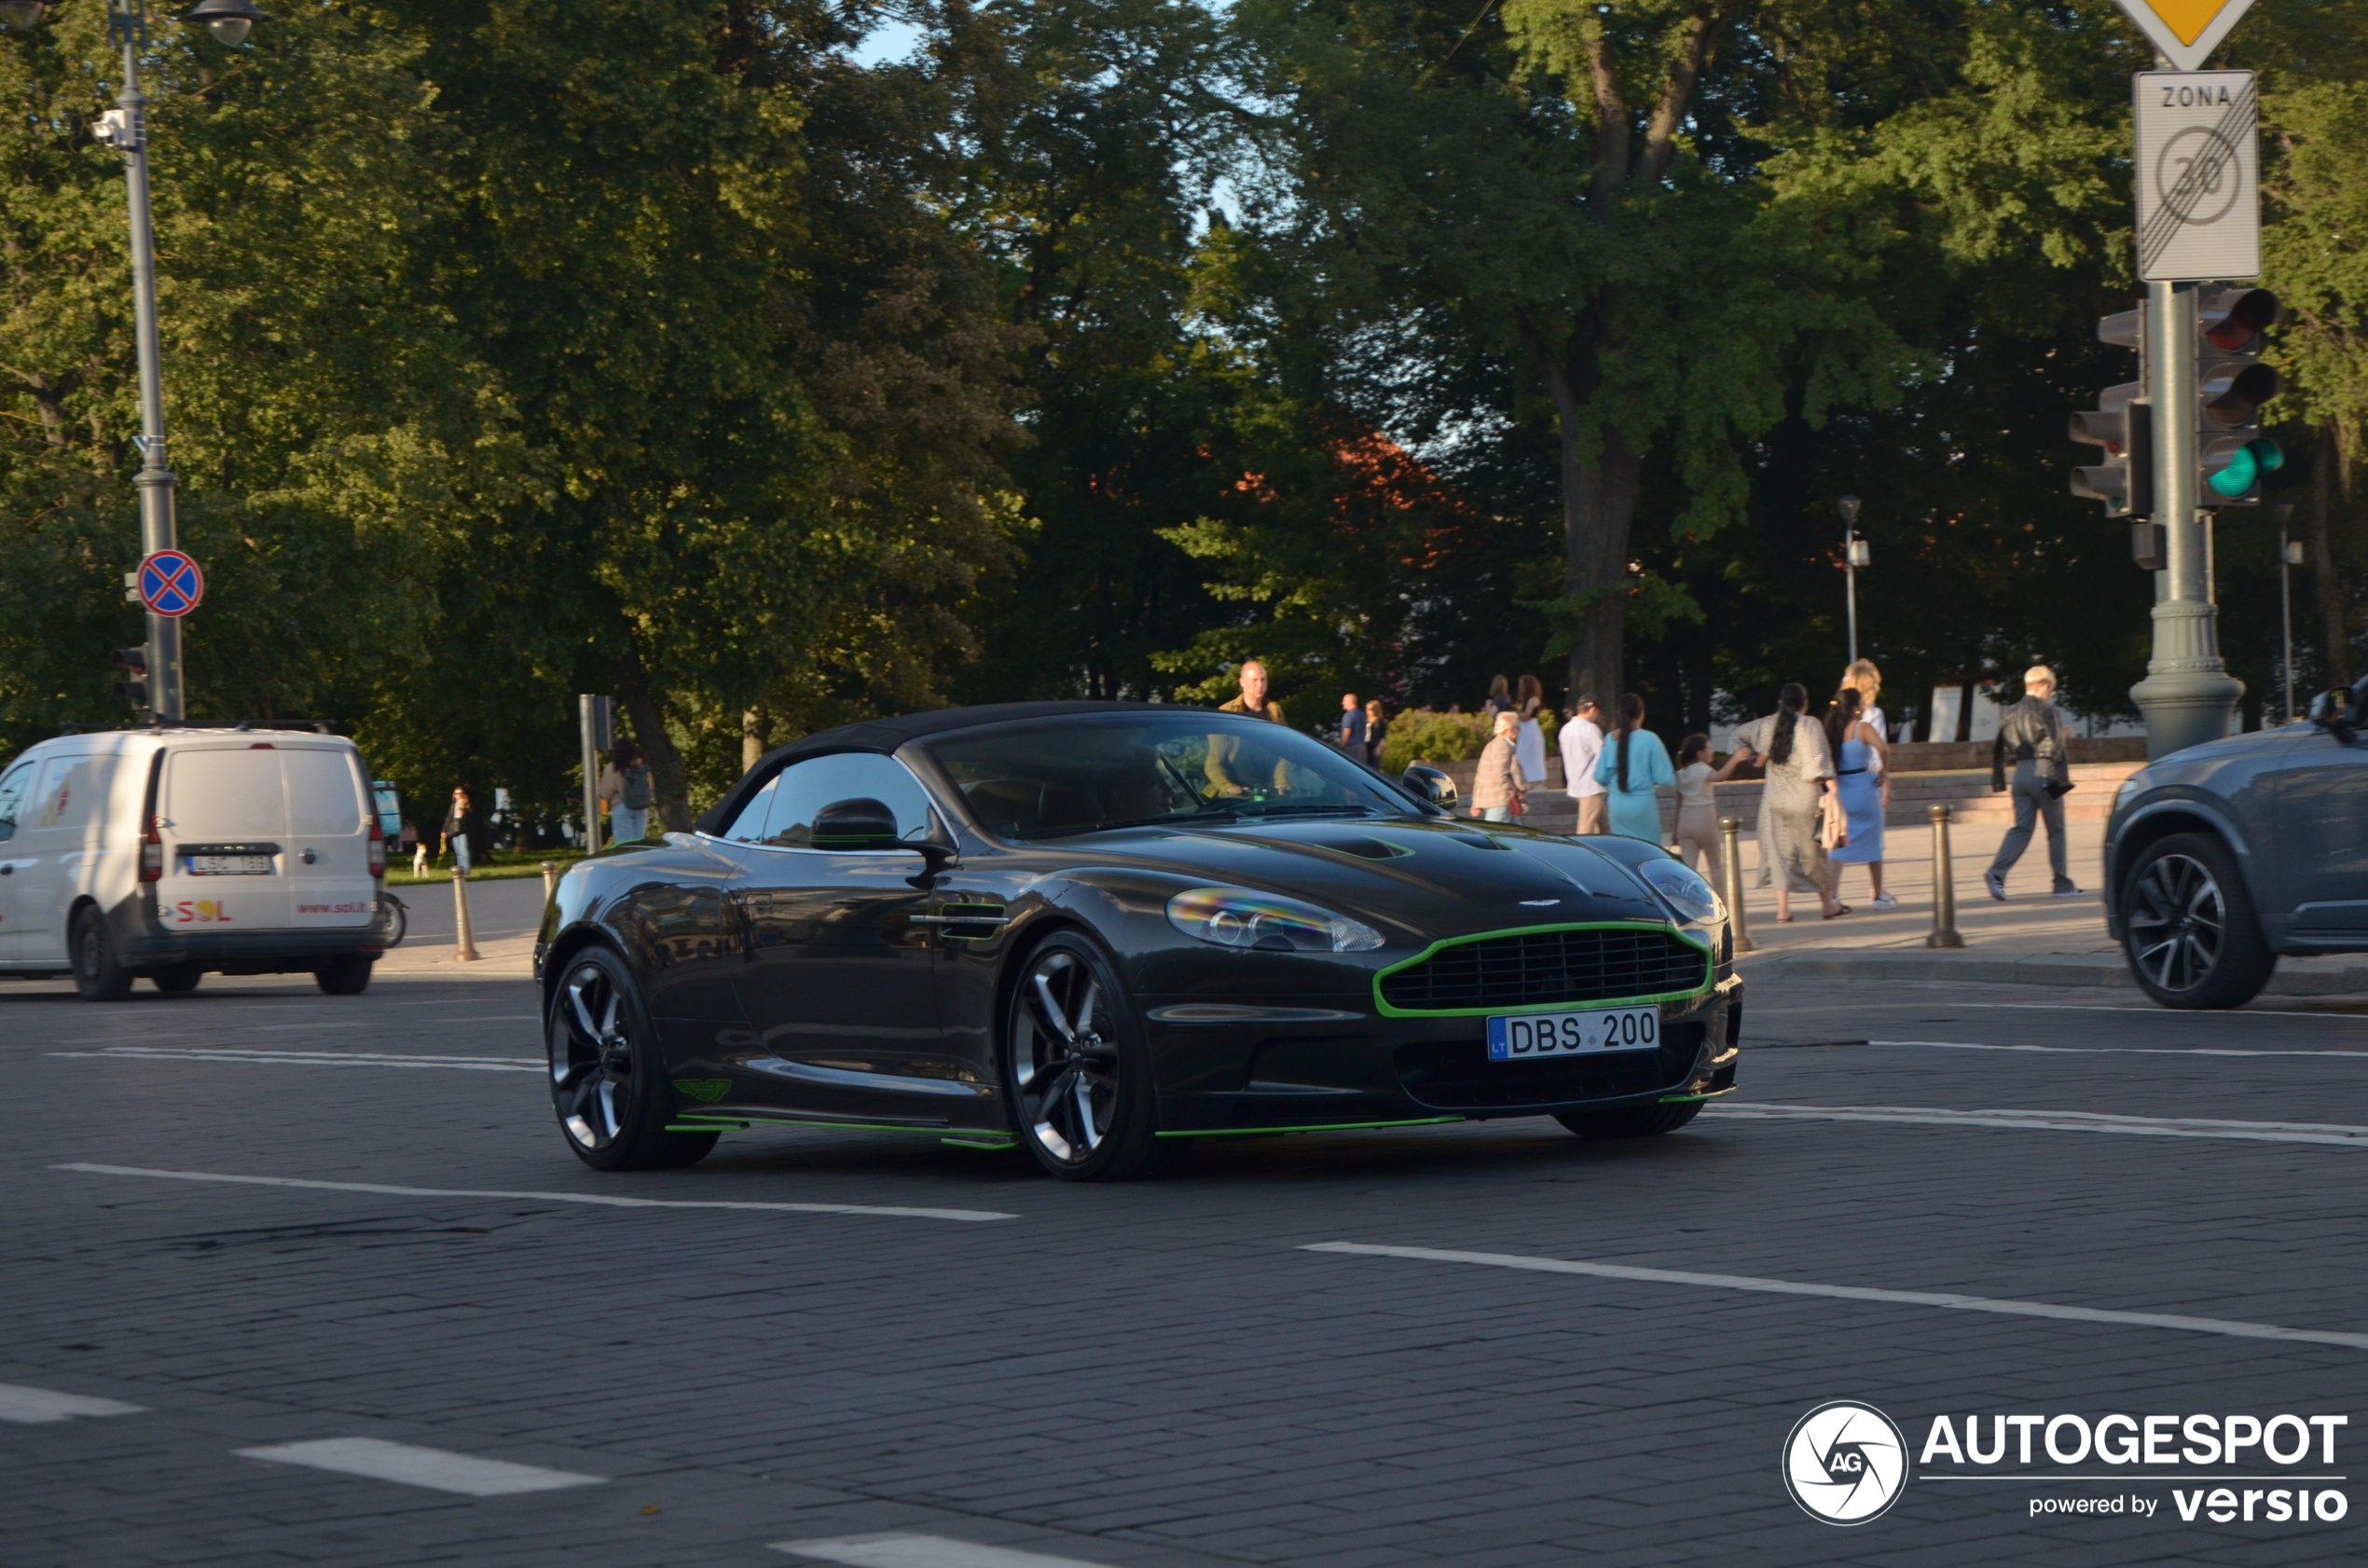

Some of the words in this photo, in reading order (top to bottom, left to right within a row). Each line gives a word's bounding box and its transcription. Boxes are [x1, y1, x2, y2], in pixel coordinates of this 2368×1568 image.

[2162, 86, 2232, 108] ZONA
[176, 900, 232, 922] SOL
[1511, 1017, 1581, 1053] DBS
[1603, 1011, 1655, 1047] 200
[1492, 1042, 1506, 1053] LT
